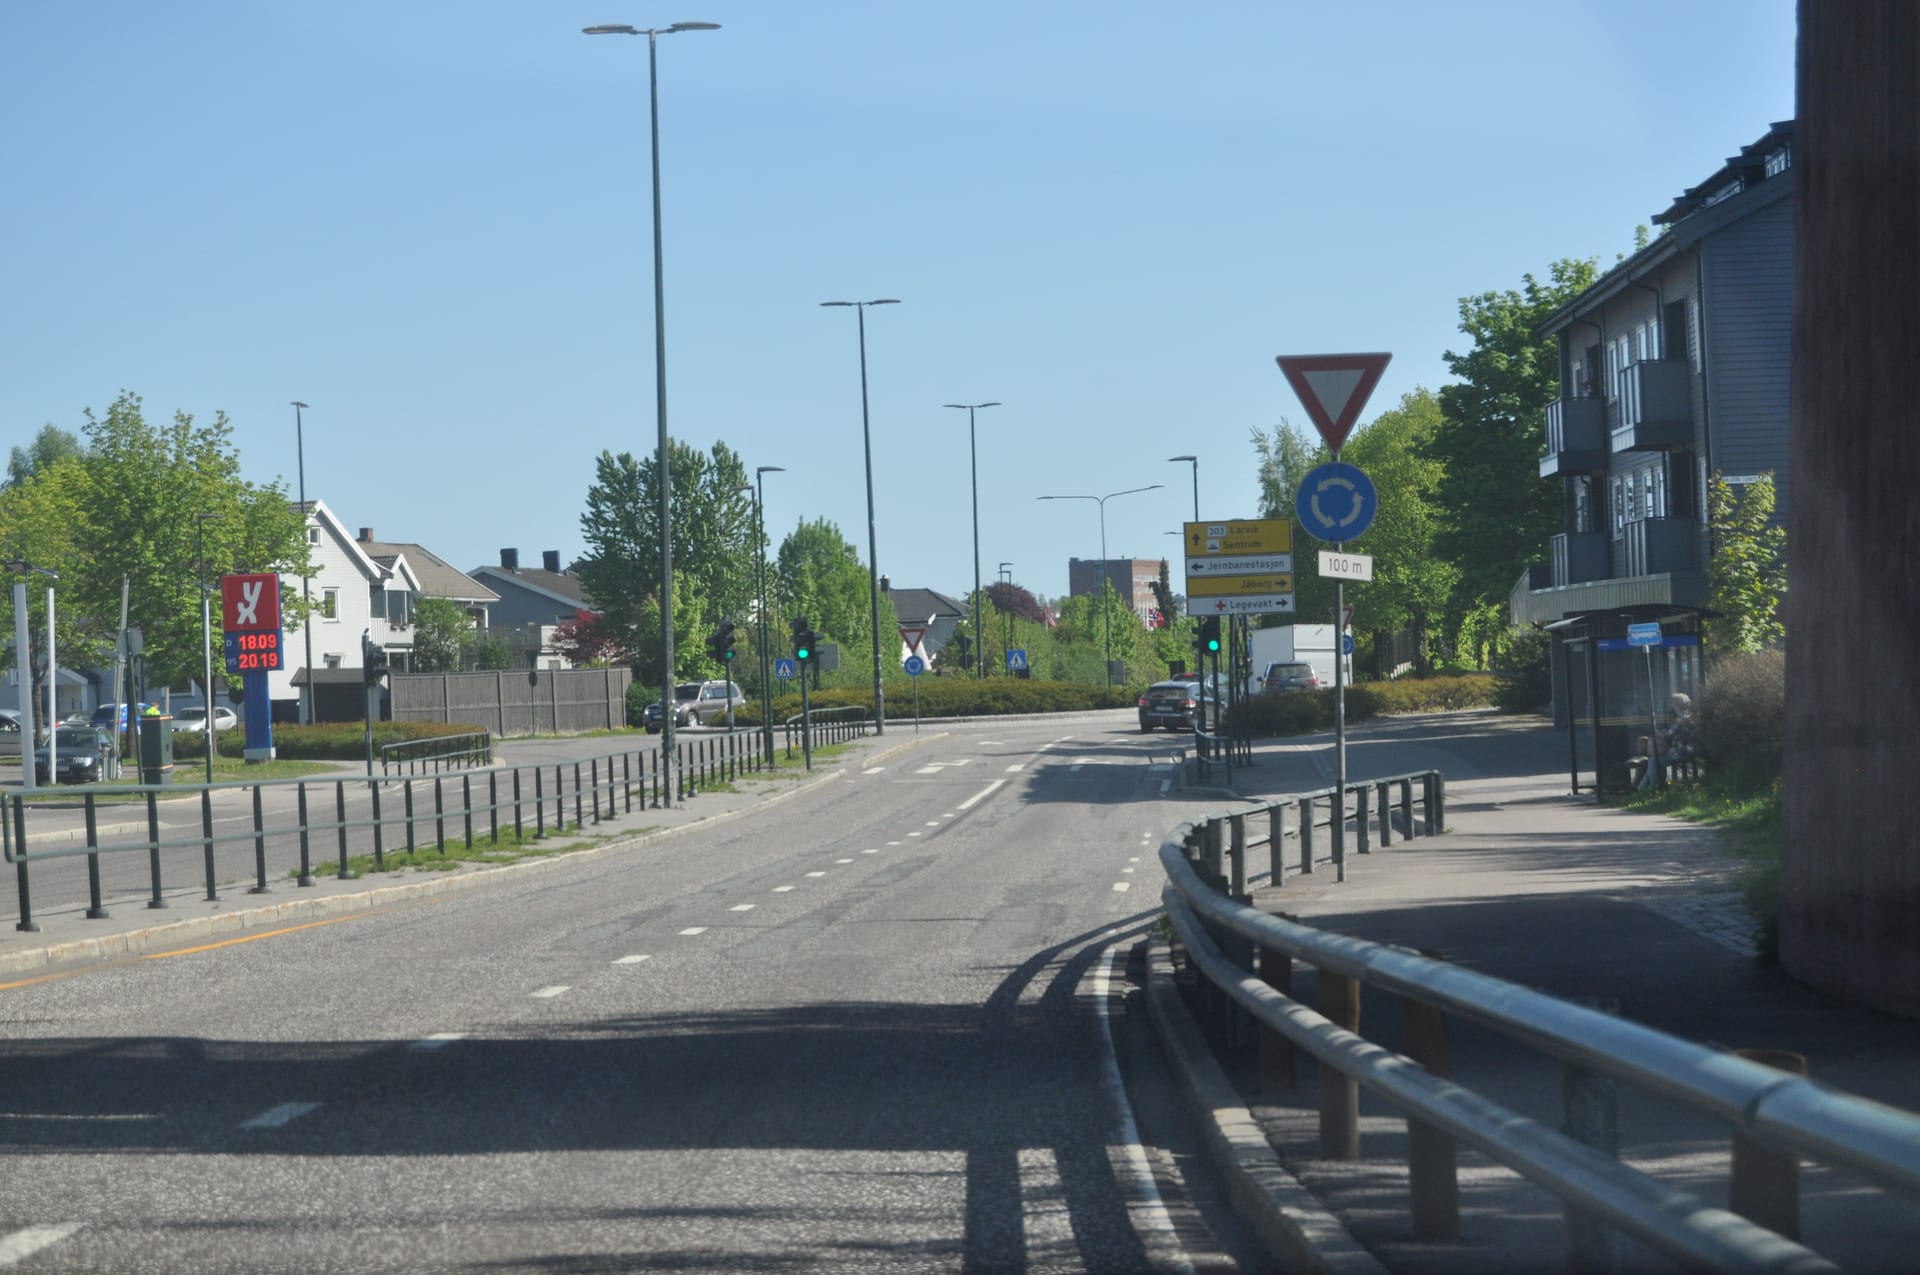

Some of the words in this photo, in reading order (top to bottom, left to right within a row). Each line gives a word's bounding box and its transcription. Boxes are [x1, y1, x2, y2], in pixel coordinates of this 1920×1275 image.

[1209, 527, 1225, 536] 303
[1230, 526, 1259, 535] Larvik
[1223, 540, 1263, 549] Sentrum
[1207, 560, 1285, 570] Jernbanestasjon
[1328, 558, 1348, 573] 100
[1352, 563, 1362, 574] m
[1241, 578, 1273, 589] Jåberg
[1230, 599, 1273, 610] Legevakt
[238, 652, 279, 669] 20.19
